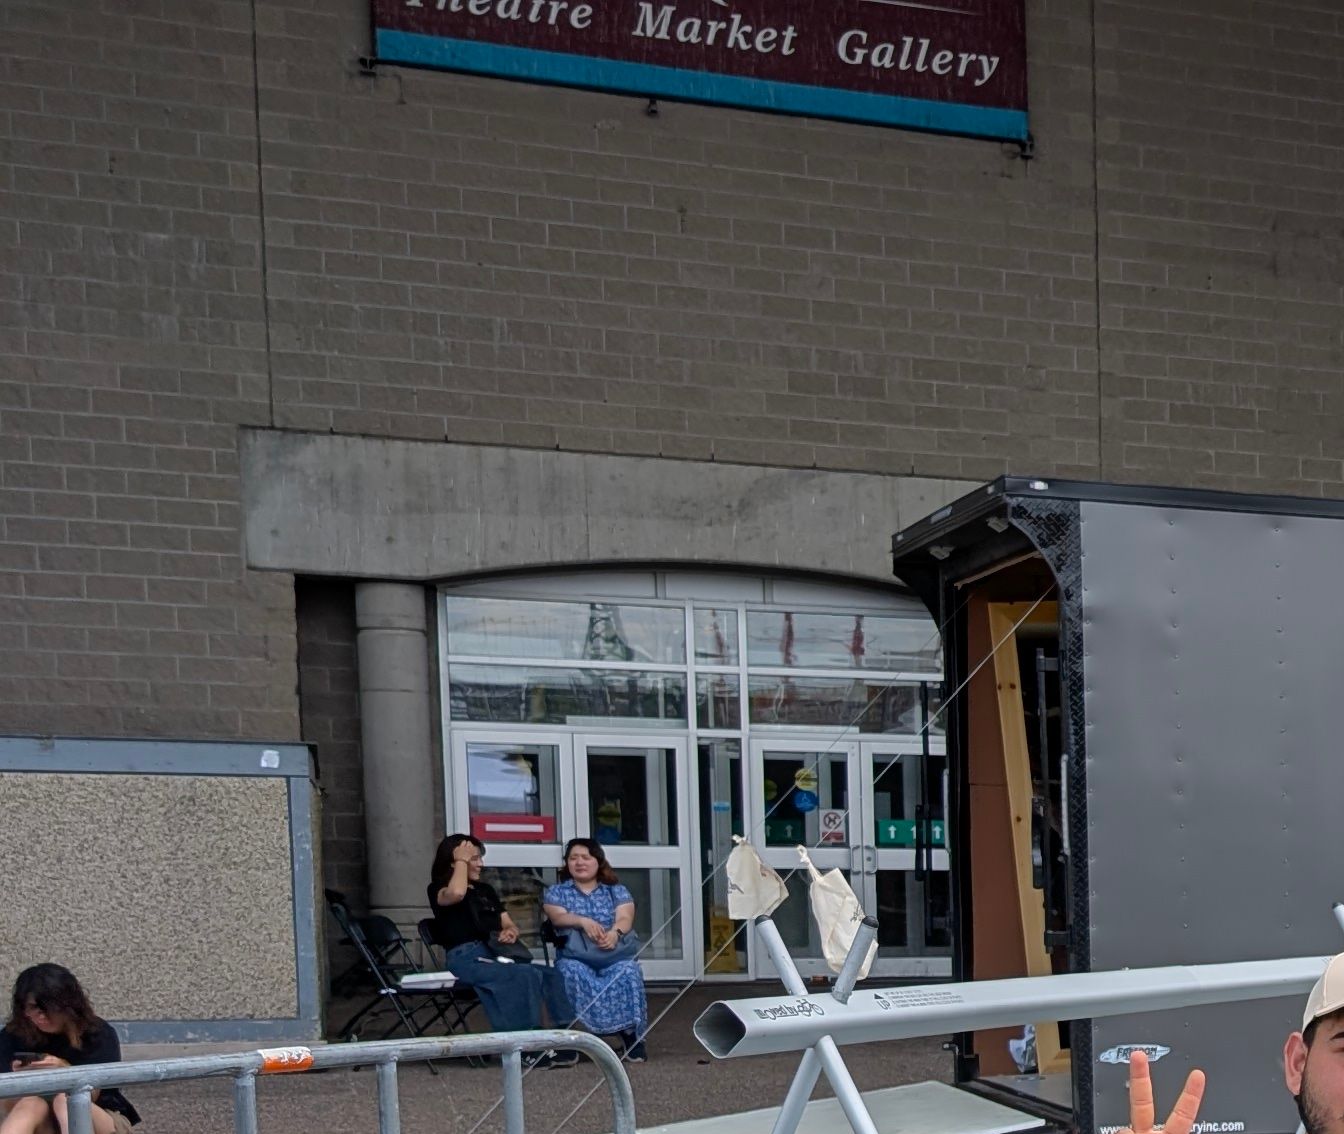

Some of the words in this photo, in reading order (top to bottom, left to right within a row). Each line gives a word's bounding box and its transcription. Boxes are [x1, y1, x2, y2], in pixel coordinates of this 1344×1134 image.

[405, 0, 593, 29] eatre
[631, 1, 798, 56] Market
[837, 29, 1000, 87] Gallery
